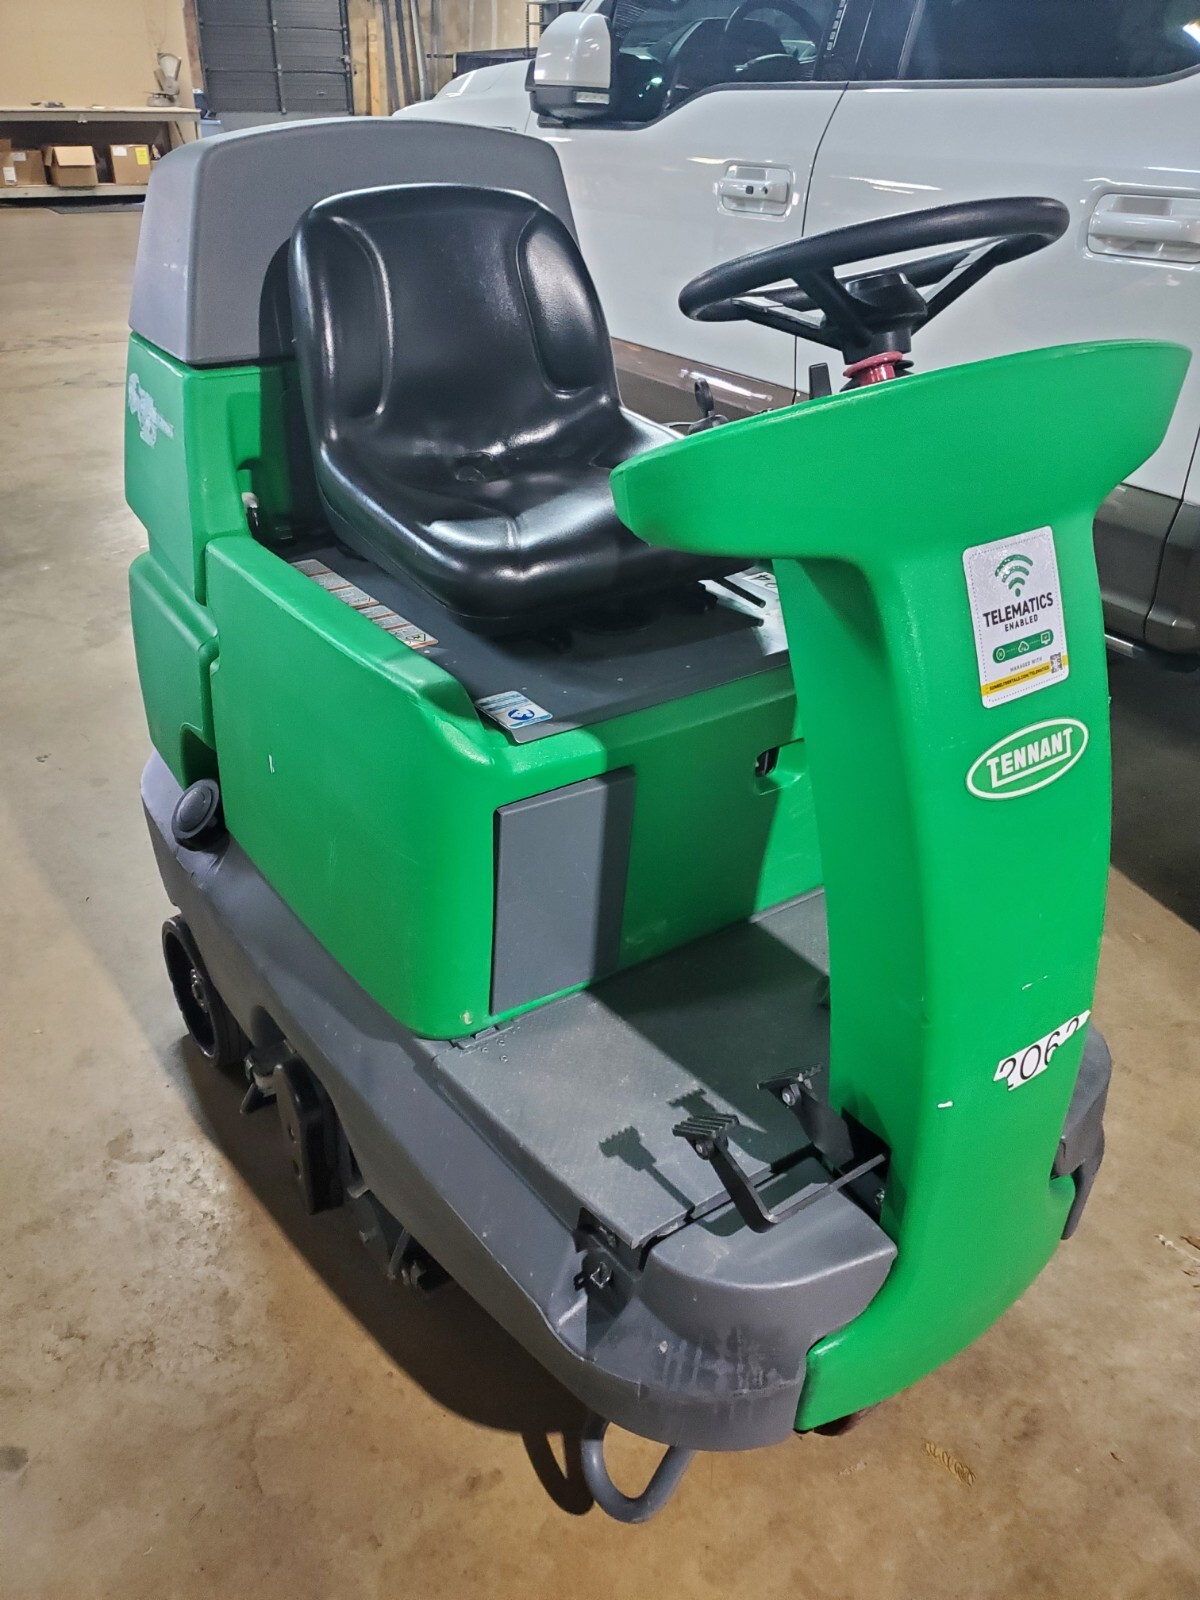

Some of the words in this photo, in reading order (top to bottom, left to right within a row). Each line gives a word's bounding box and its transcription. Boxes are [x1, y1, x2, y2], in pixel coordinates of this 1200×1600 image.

[982, 592, 1054, 628] TELEMATICS
[1004, 614, 1038, 632] ENABLED
[1010, 660, 1030, 672] MANAGED
[1032, 656, 1042, 664] WITH
[986, 727, 1074, 789] TENNANT
